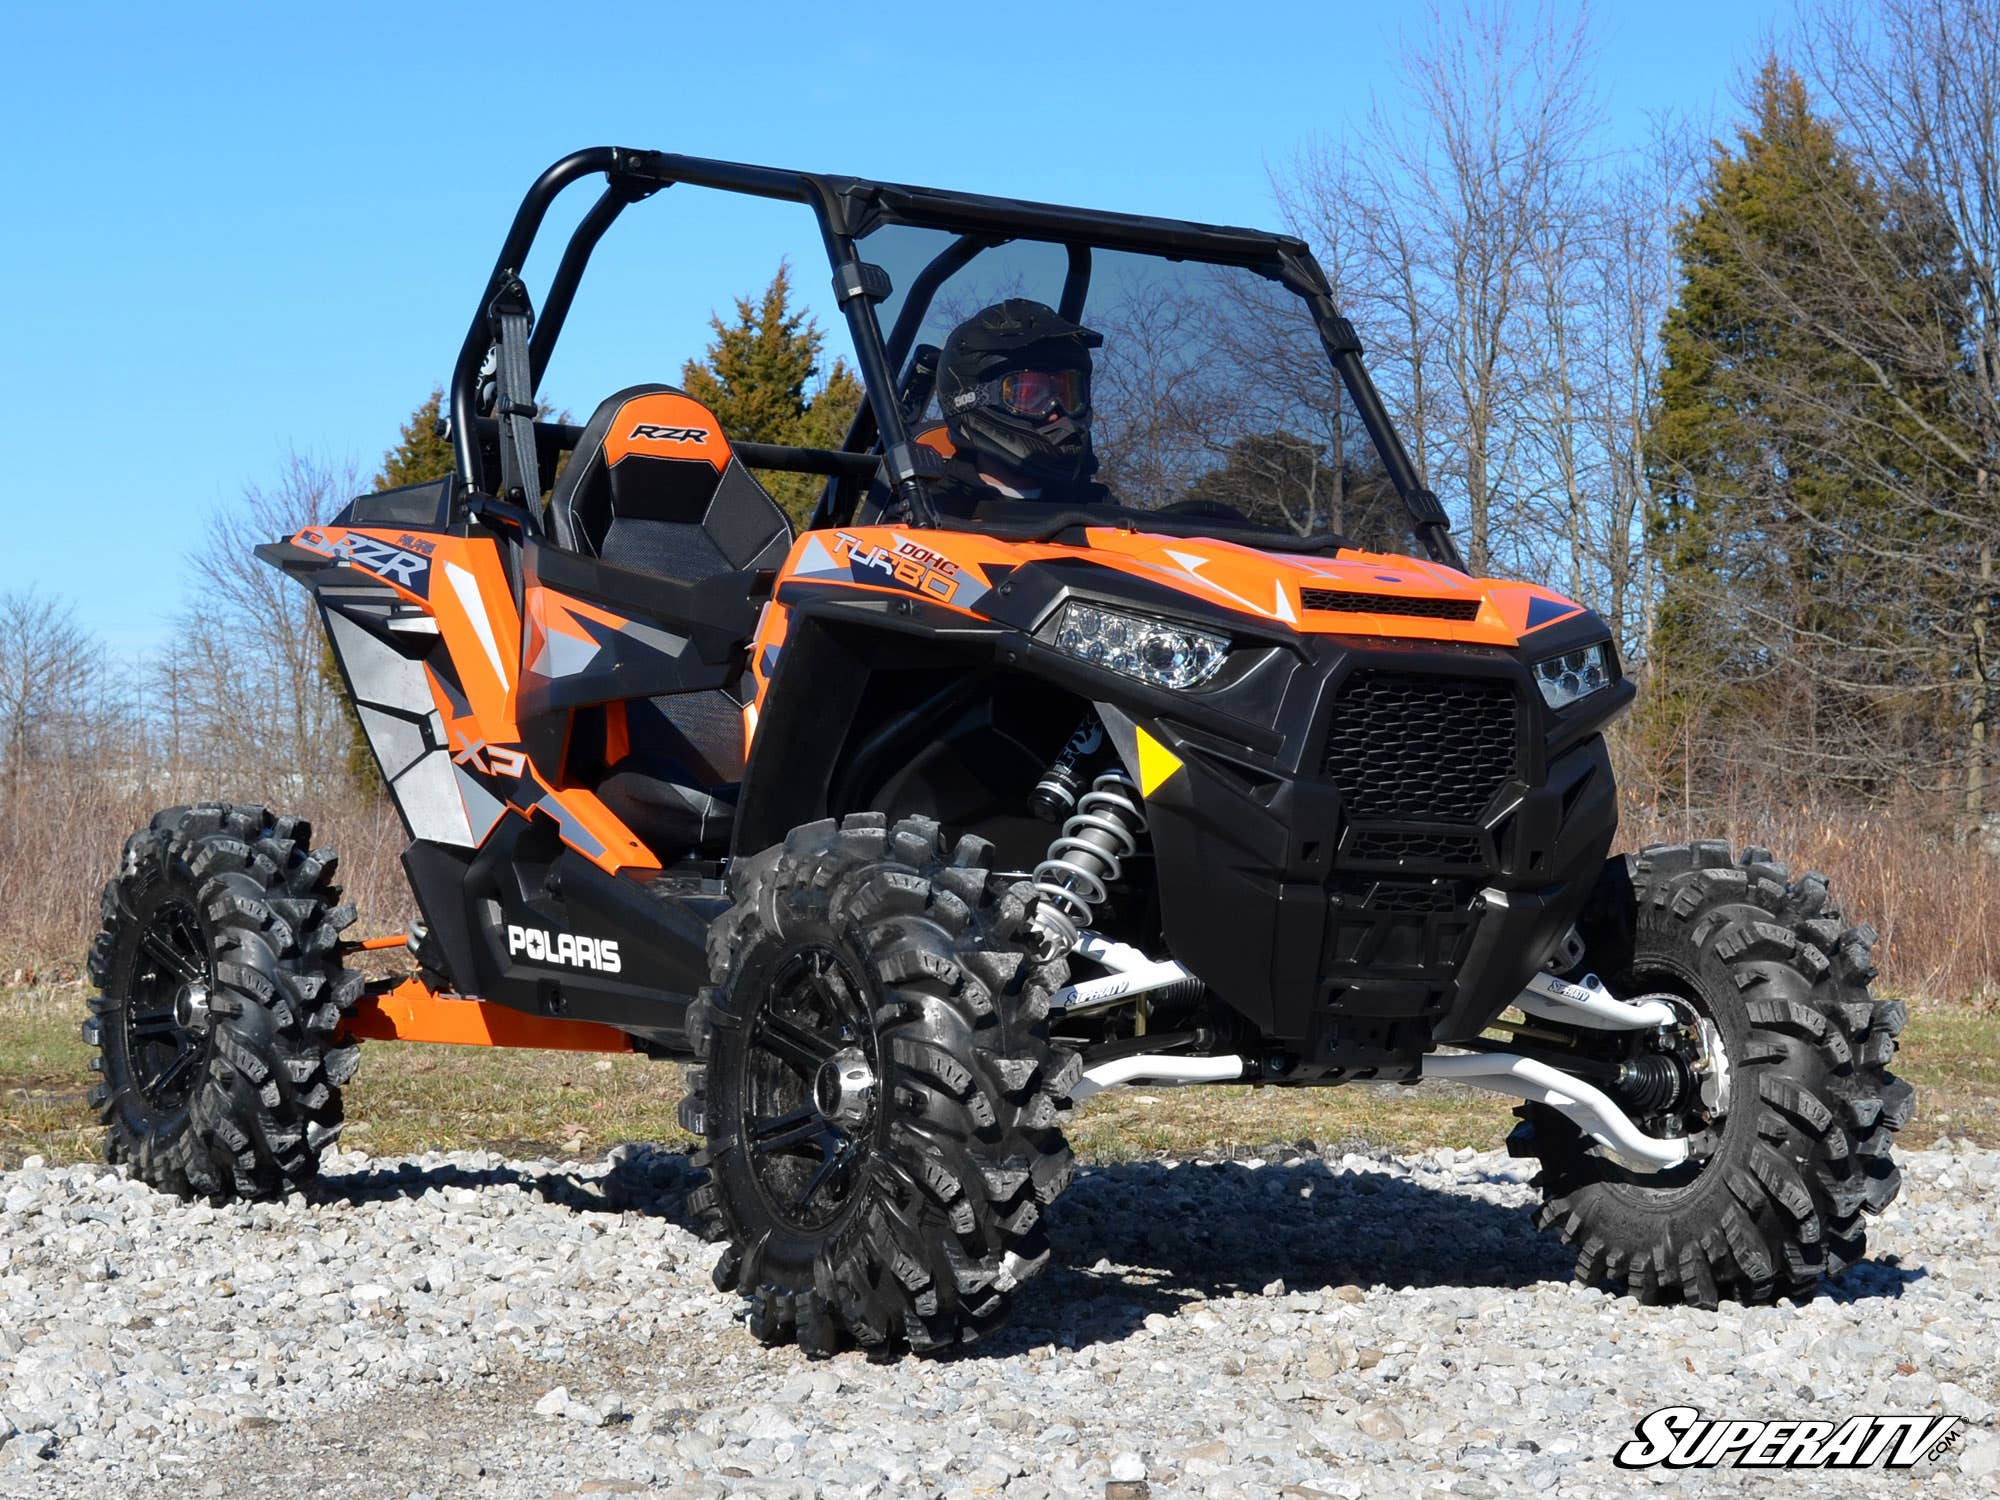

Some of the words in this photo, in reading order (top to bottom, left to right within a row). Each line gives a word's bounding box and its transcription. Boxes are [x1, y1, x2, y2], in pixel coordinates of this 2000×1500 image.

[627, 423, 711, 445] RZR
[332, 531, 429, 587] RZR
[832, 530, 960, 604] TURBO
[899, 542, 960, 577] DOHC
[451, 730, 527, 779] XP
[507, 924, 622, 974] POLARIS
